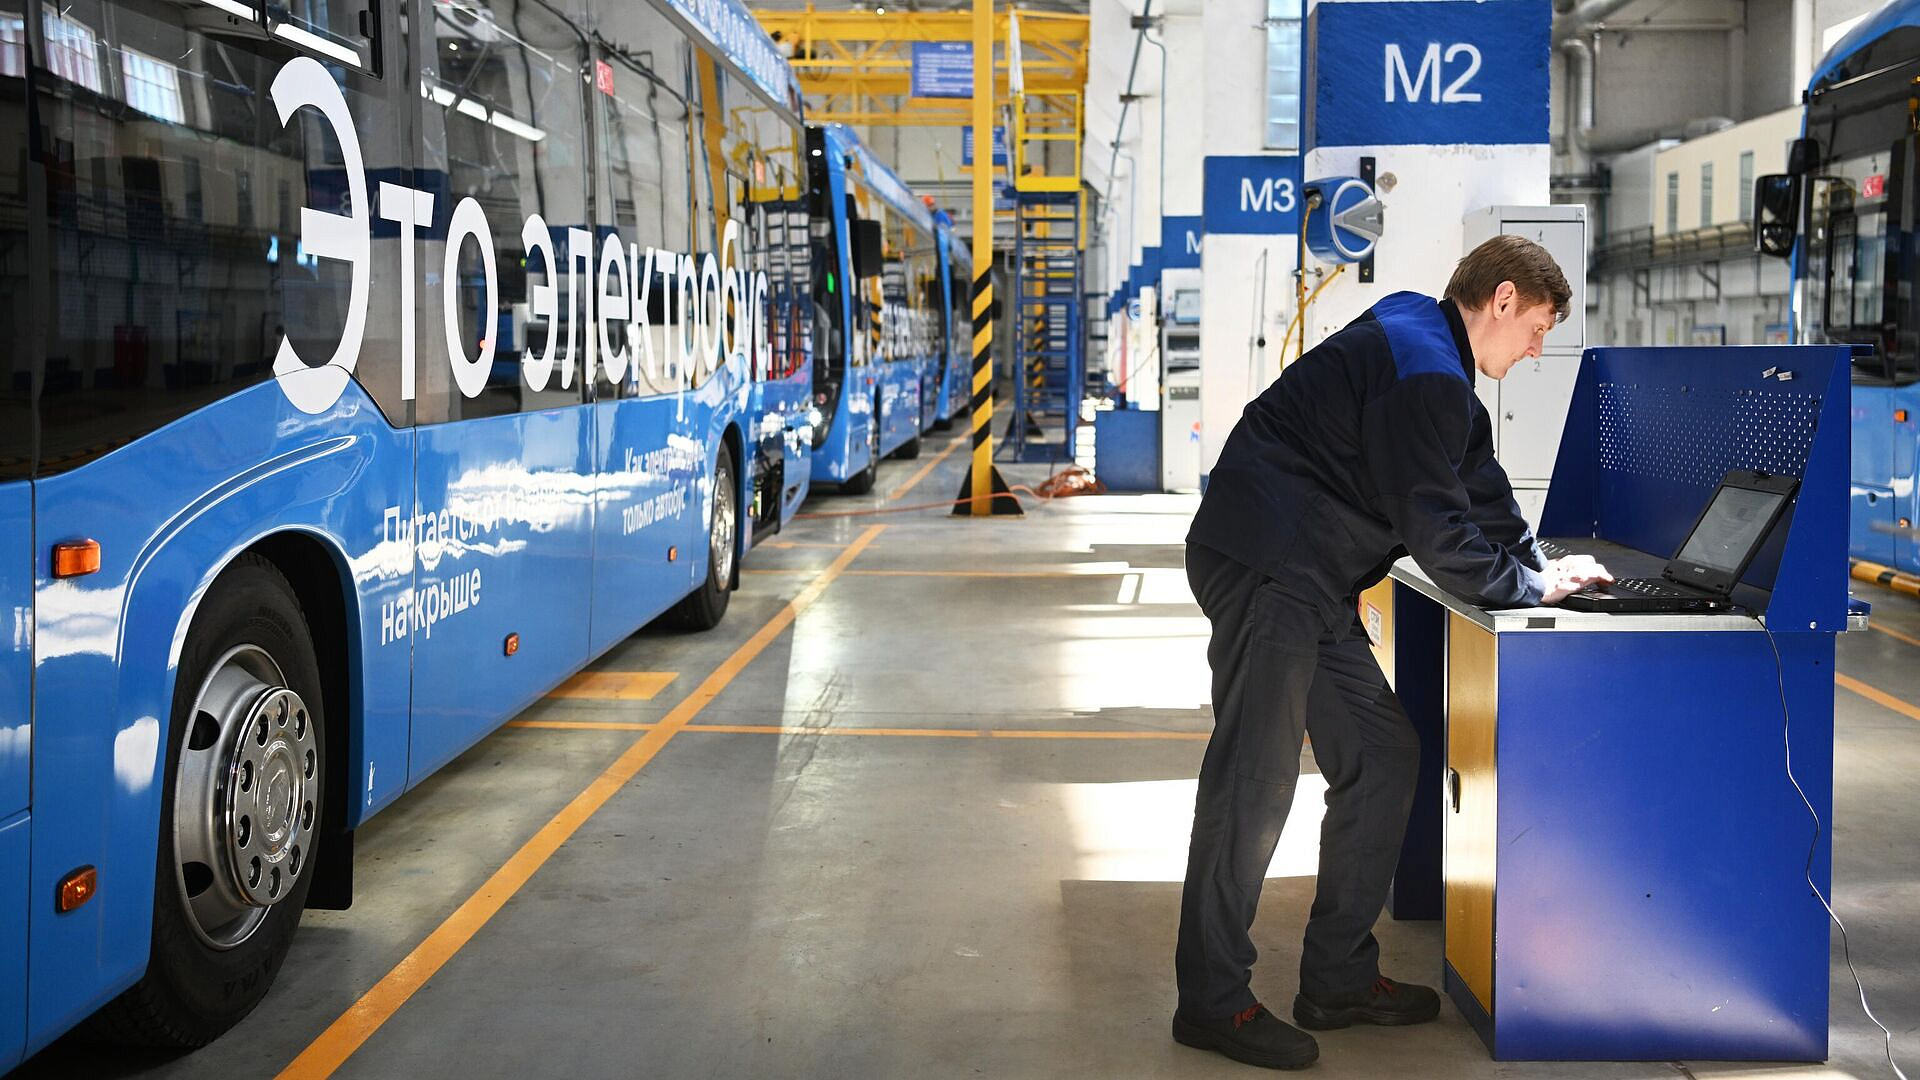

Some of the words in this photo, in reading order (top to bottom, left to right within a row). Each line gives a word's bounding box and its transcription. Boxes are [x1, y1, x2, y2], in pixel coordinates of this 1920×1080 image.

[1384, 43, 1482, 103] M2
[1240, 177, 1296, 212] M3
[270, 56, 499, 415] Это
[521, 213, 769, 422] электробус
[1534, 361, 1542, 372] 2
[623, 498, 655, 536] только
[654, 479, 687, 523] автобус
[382, 596, 408, 646] на
[413, 568, 482, 640] крыше
